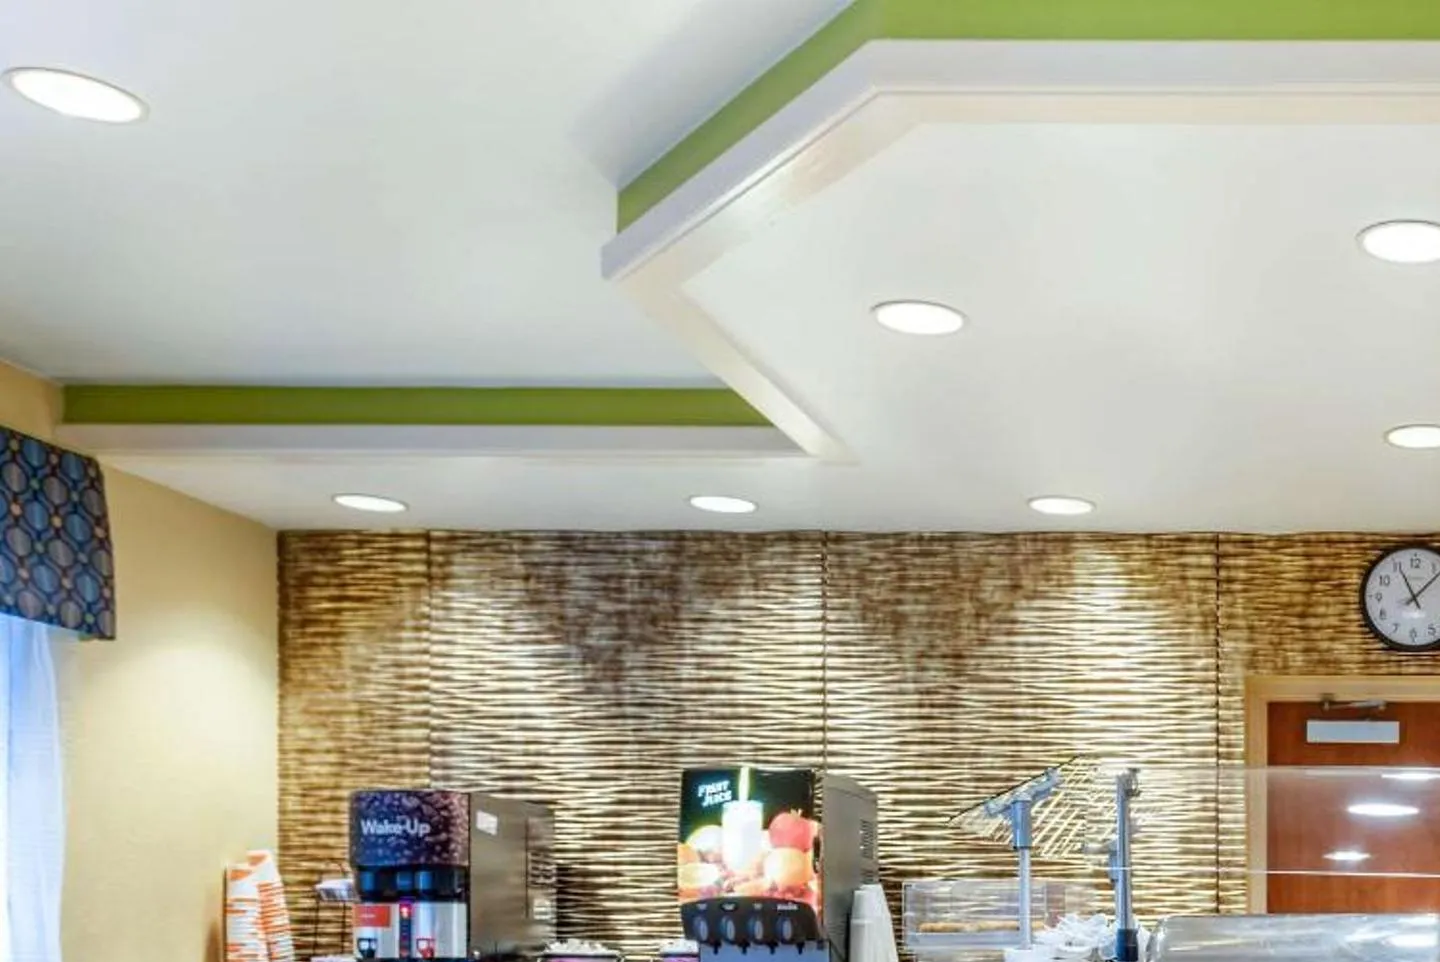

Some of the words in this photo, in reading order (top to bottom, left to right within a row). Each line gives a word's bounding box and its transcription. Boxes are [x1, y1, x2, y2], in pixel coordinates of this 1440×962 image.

[1409, 557, 1421, 569] 12
[1379, 574, 1391, 587] 10
[1374, 592, 1383, 604] 9
[1392, 622, 1399, 634] 7
[1427, 624, 1437, 636] 5
